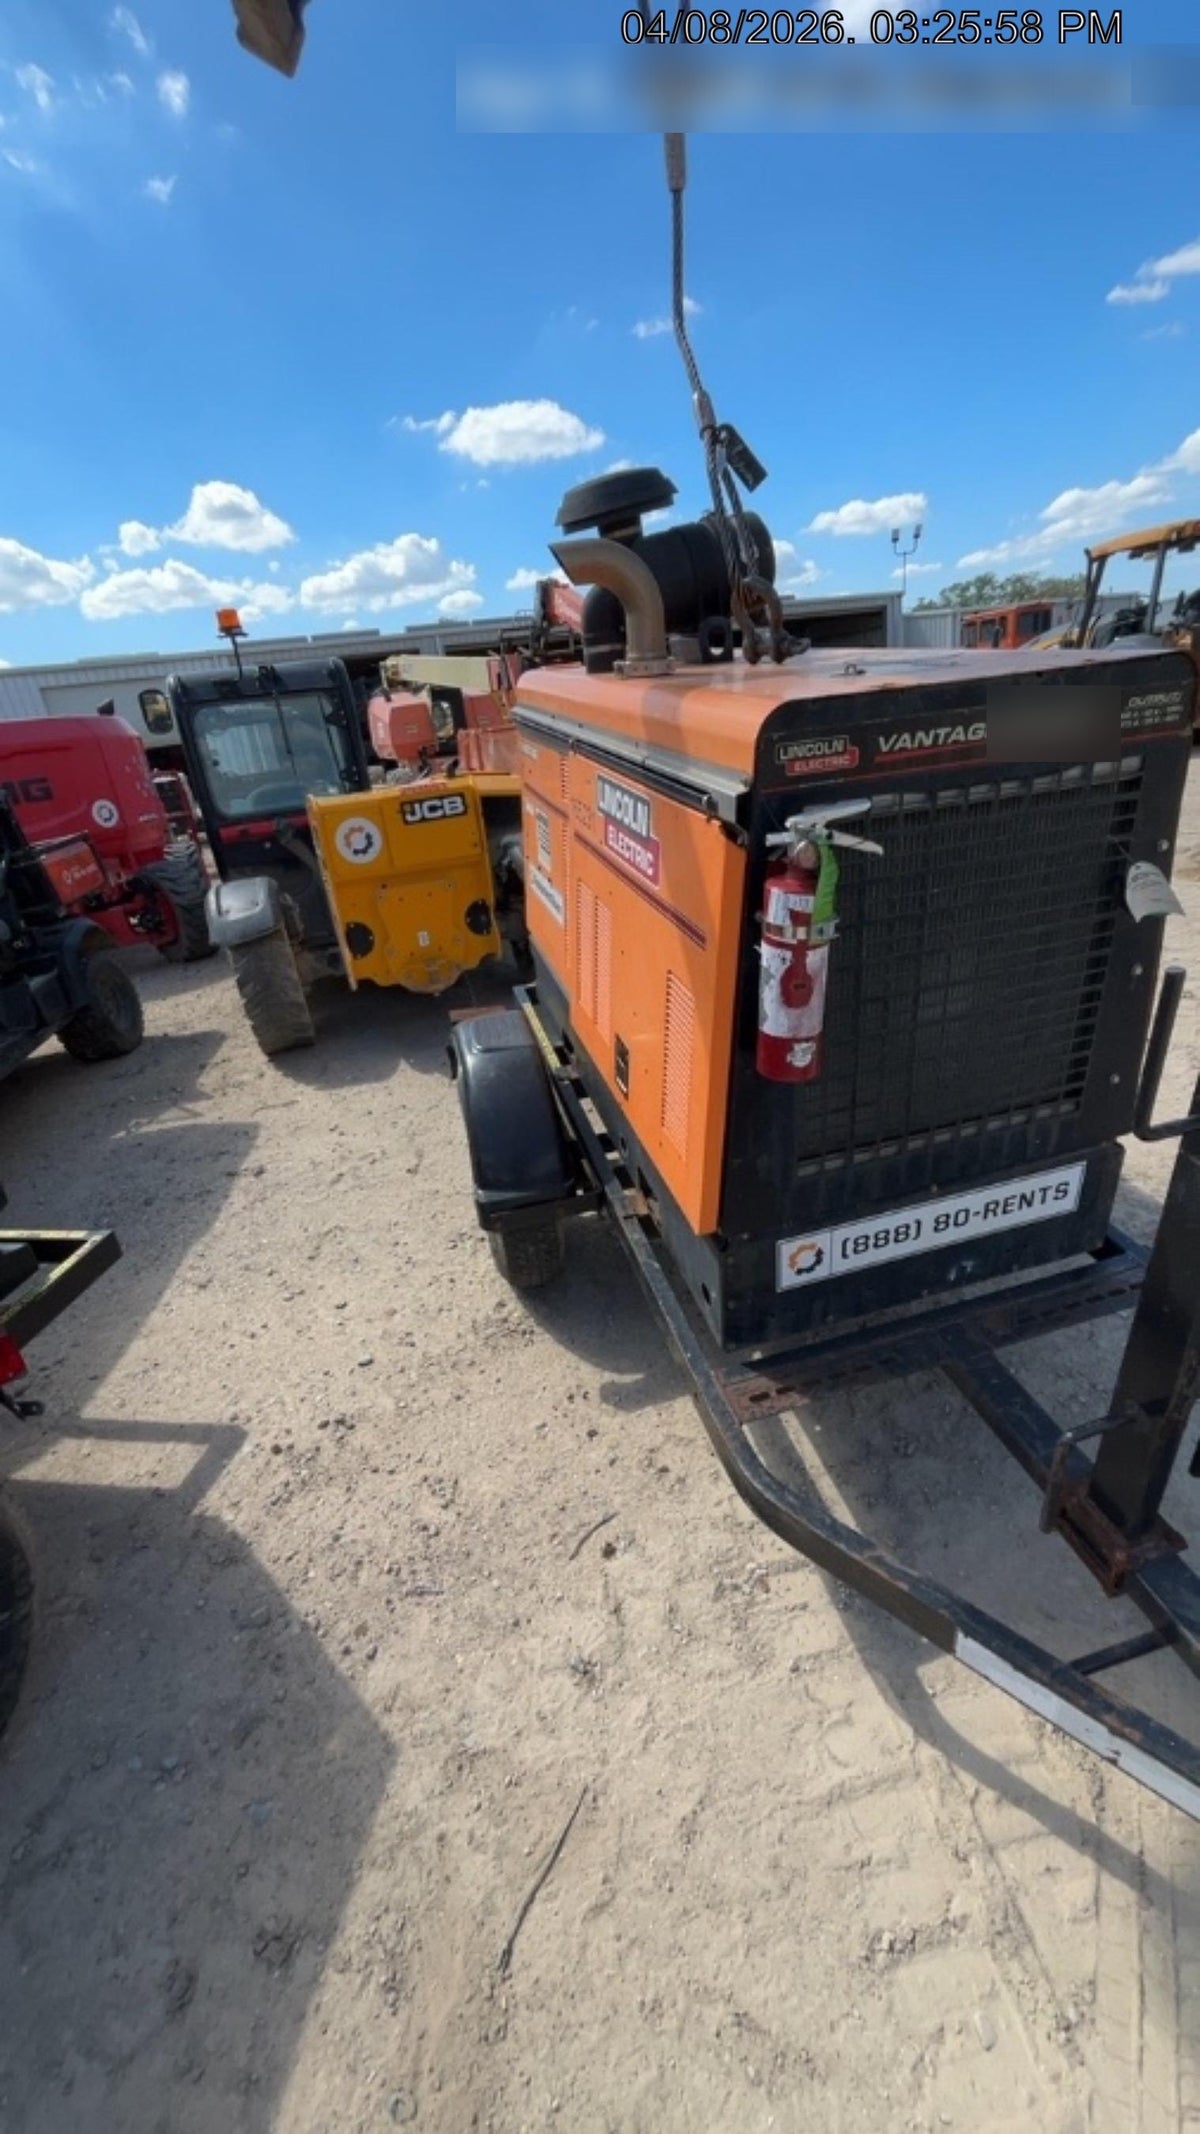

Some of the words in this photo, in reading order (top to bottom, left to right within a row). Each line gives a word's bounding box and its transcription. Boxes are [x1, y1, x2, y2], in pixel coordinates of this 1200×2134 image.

[779, 739, 846, 760] LINCOLN
[879, 722, 988, 753] VANTAG
[793, 755, 852, 772] ELECTRIC
[404, 796, 465, 822] JCB
[600, 783, 649, 838] LINCOLN
[607, 823, 654, 876] ELECTRIC
[841, 1219, 921, 1260] (888)
[933, 1182, 1071, 1234] 80-RENTS
